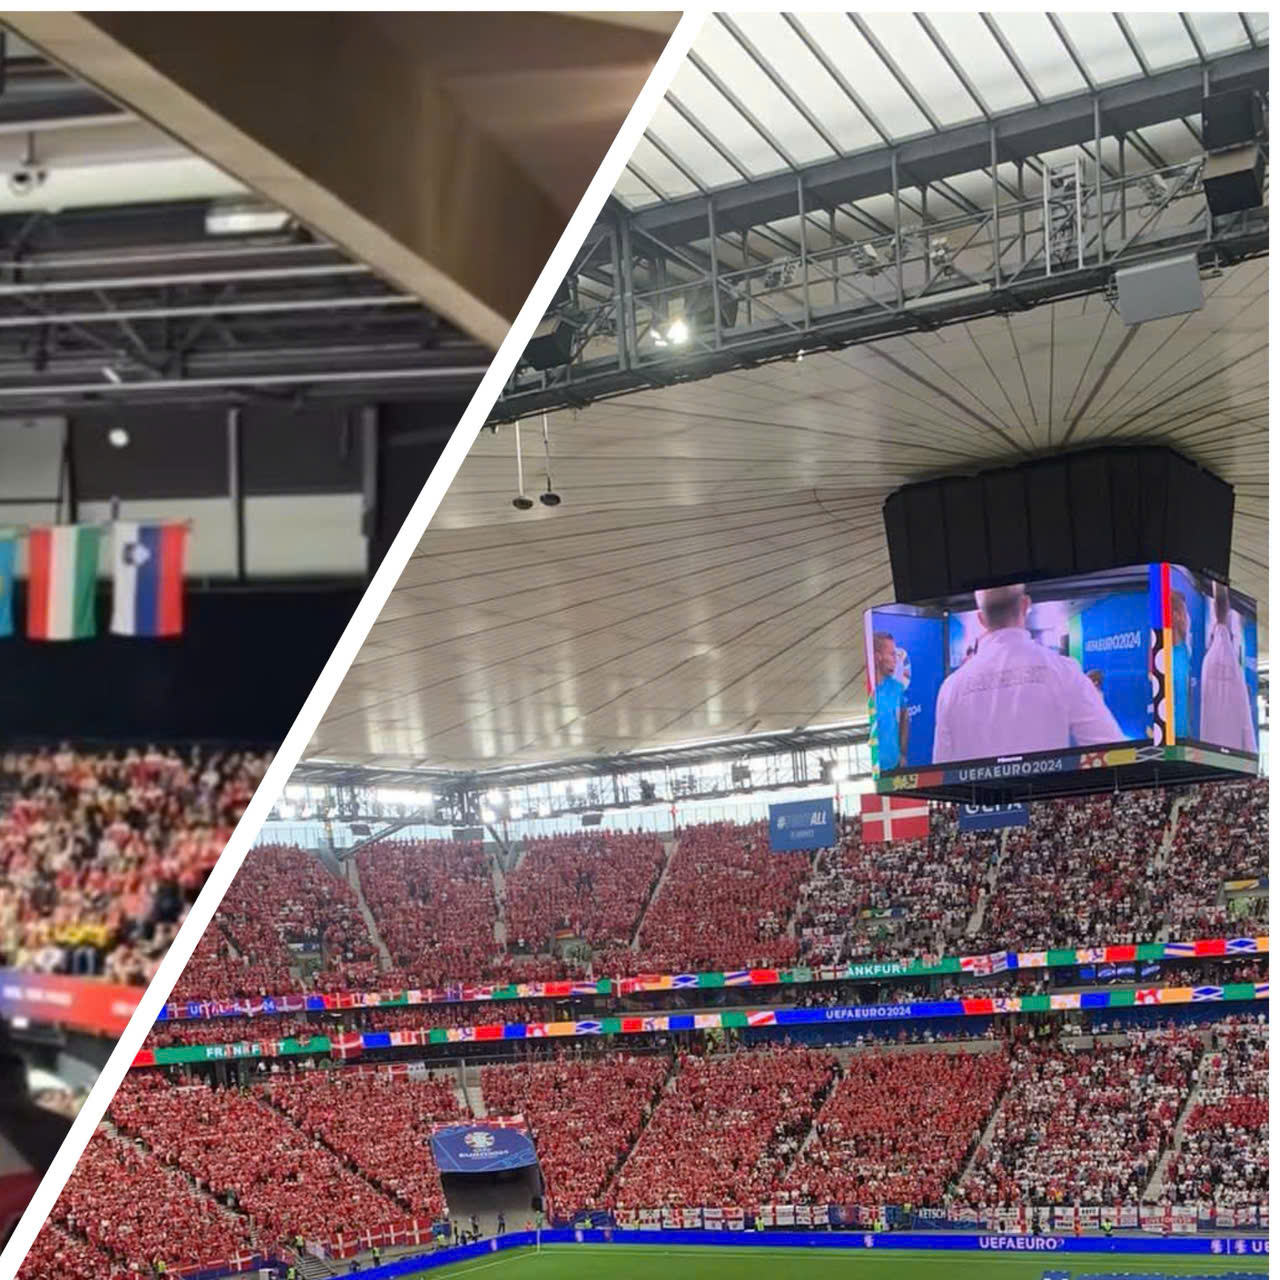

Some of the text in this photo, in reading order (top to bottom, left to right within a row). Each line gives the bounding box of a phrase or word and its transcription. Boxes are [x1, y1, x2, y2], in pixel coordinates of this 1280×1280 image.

[958, 759, 1062, 781] UEFAEURO2024
[846, 964, 908, 977] ANKFURT
[825, 1006, 912, 1020] UEFAEURO2024
